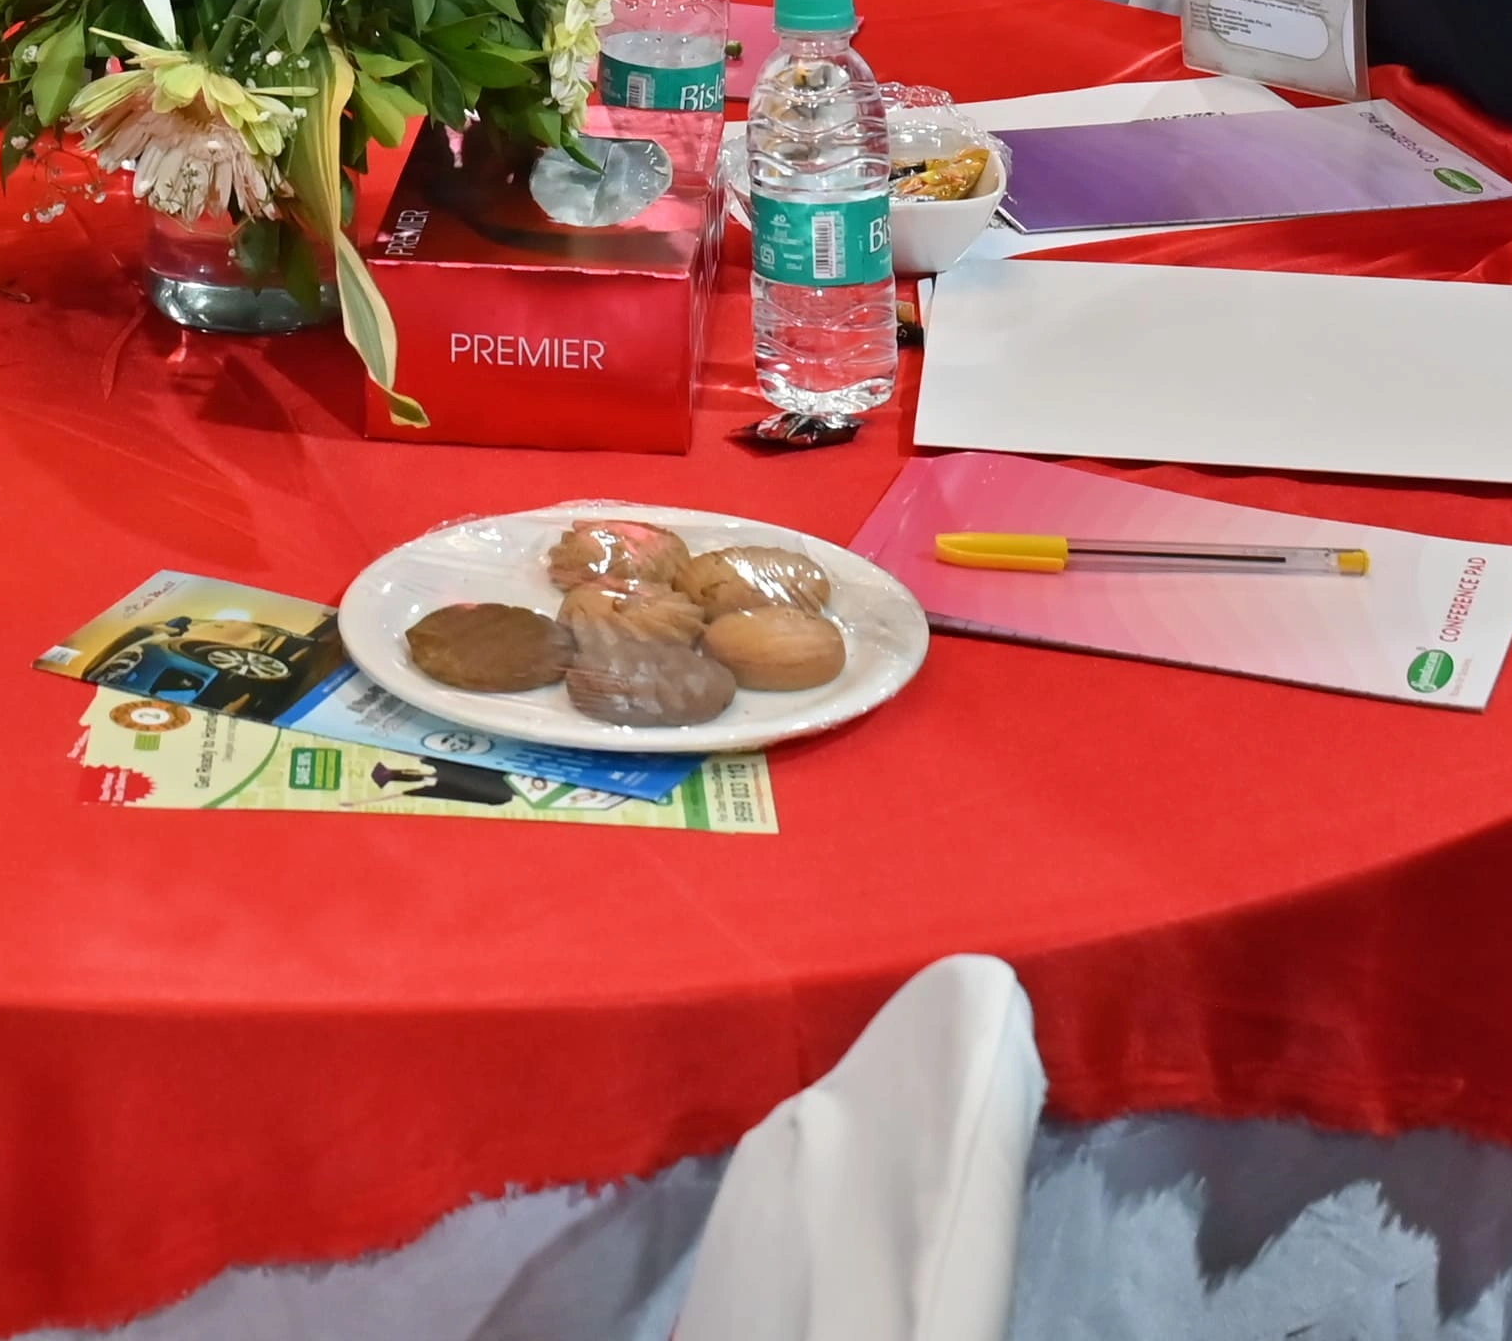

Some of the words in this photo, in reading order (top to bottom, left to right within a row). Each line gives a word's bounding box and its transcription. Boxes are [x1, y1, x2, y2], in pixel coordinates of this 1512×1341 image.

[384, 209, 430, 256] PREMIER
[450, 333, 606, 370] PREMIER
[1439, 577, 1481, 643] CONFERENCE
[1463, 556, 1488, 576] PAD
